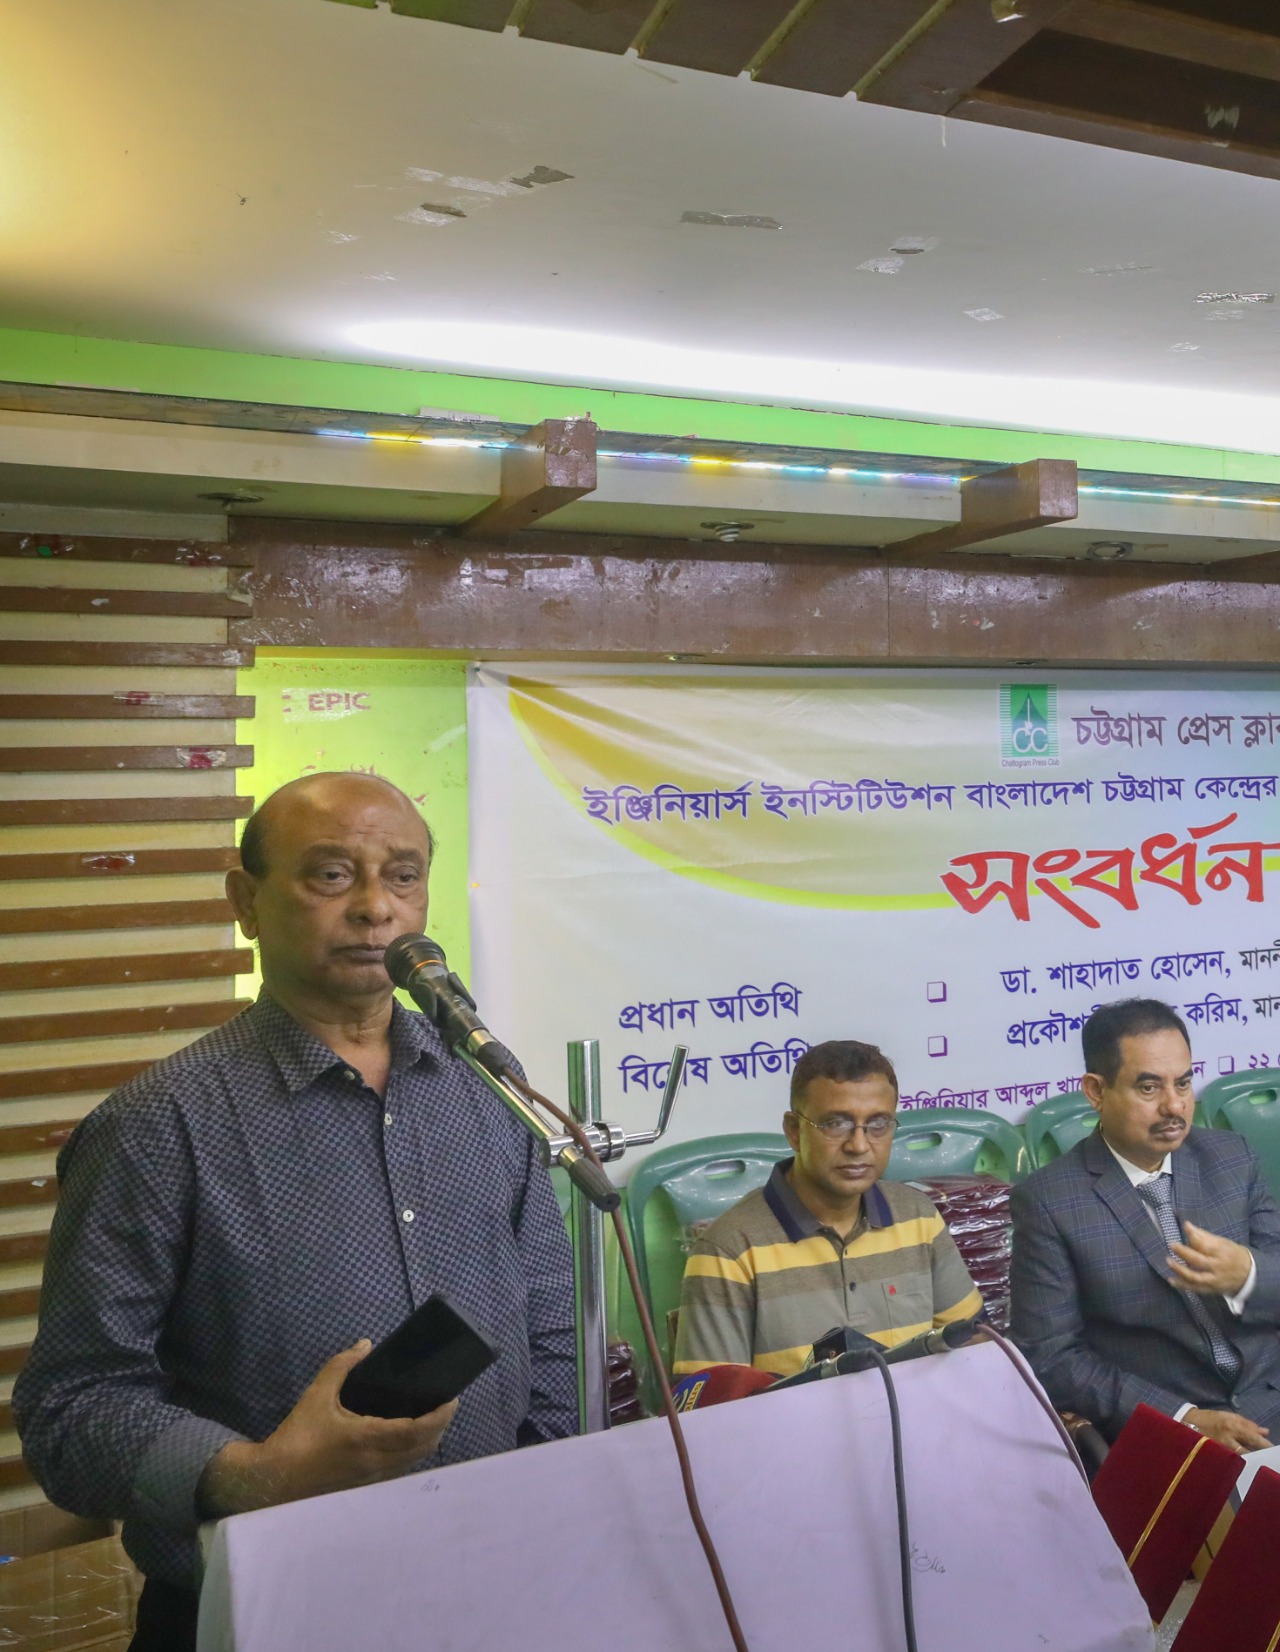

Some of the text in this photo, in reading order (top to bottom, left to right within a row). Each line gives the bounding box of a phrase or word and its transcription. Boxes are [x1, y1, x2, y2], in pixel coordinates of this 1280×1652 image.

[307, 692, 371, 711] EPIC
[1071, 706, 1167, 748] চট্টগ্রাম
[1177, 713, 1235, 746] প্রেস
[582, 781, 753, 826] ইঞ্জিনিয়ার্স
[760, 778, 956, 819] ইনস্টিটিউশন
[963, 778, 1094, 809] বাংলাদেশ
[1101, 772, 1185, 802] চট্টগ্রাম
[1195, 775, 1279, 801] কেন্দ্রের
[1000, 966, 1037, 994] ডা.
[1047, 957, 1142, 990] শাহাদাত
[1151, 951, 1231, 981] হোসেন,
[619, 981, 803, 1033] প্রধান অতিথি
[1184, 993, 1248, 1026] করিম,
[616, 1054, 713, 1094] বিেষ
[1249, 1050, 1270, 1069] ২২
[995, 1081, 1050, 1107] আব্দুল
